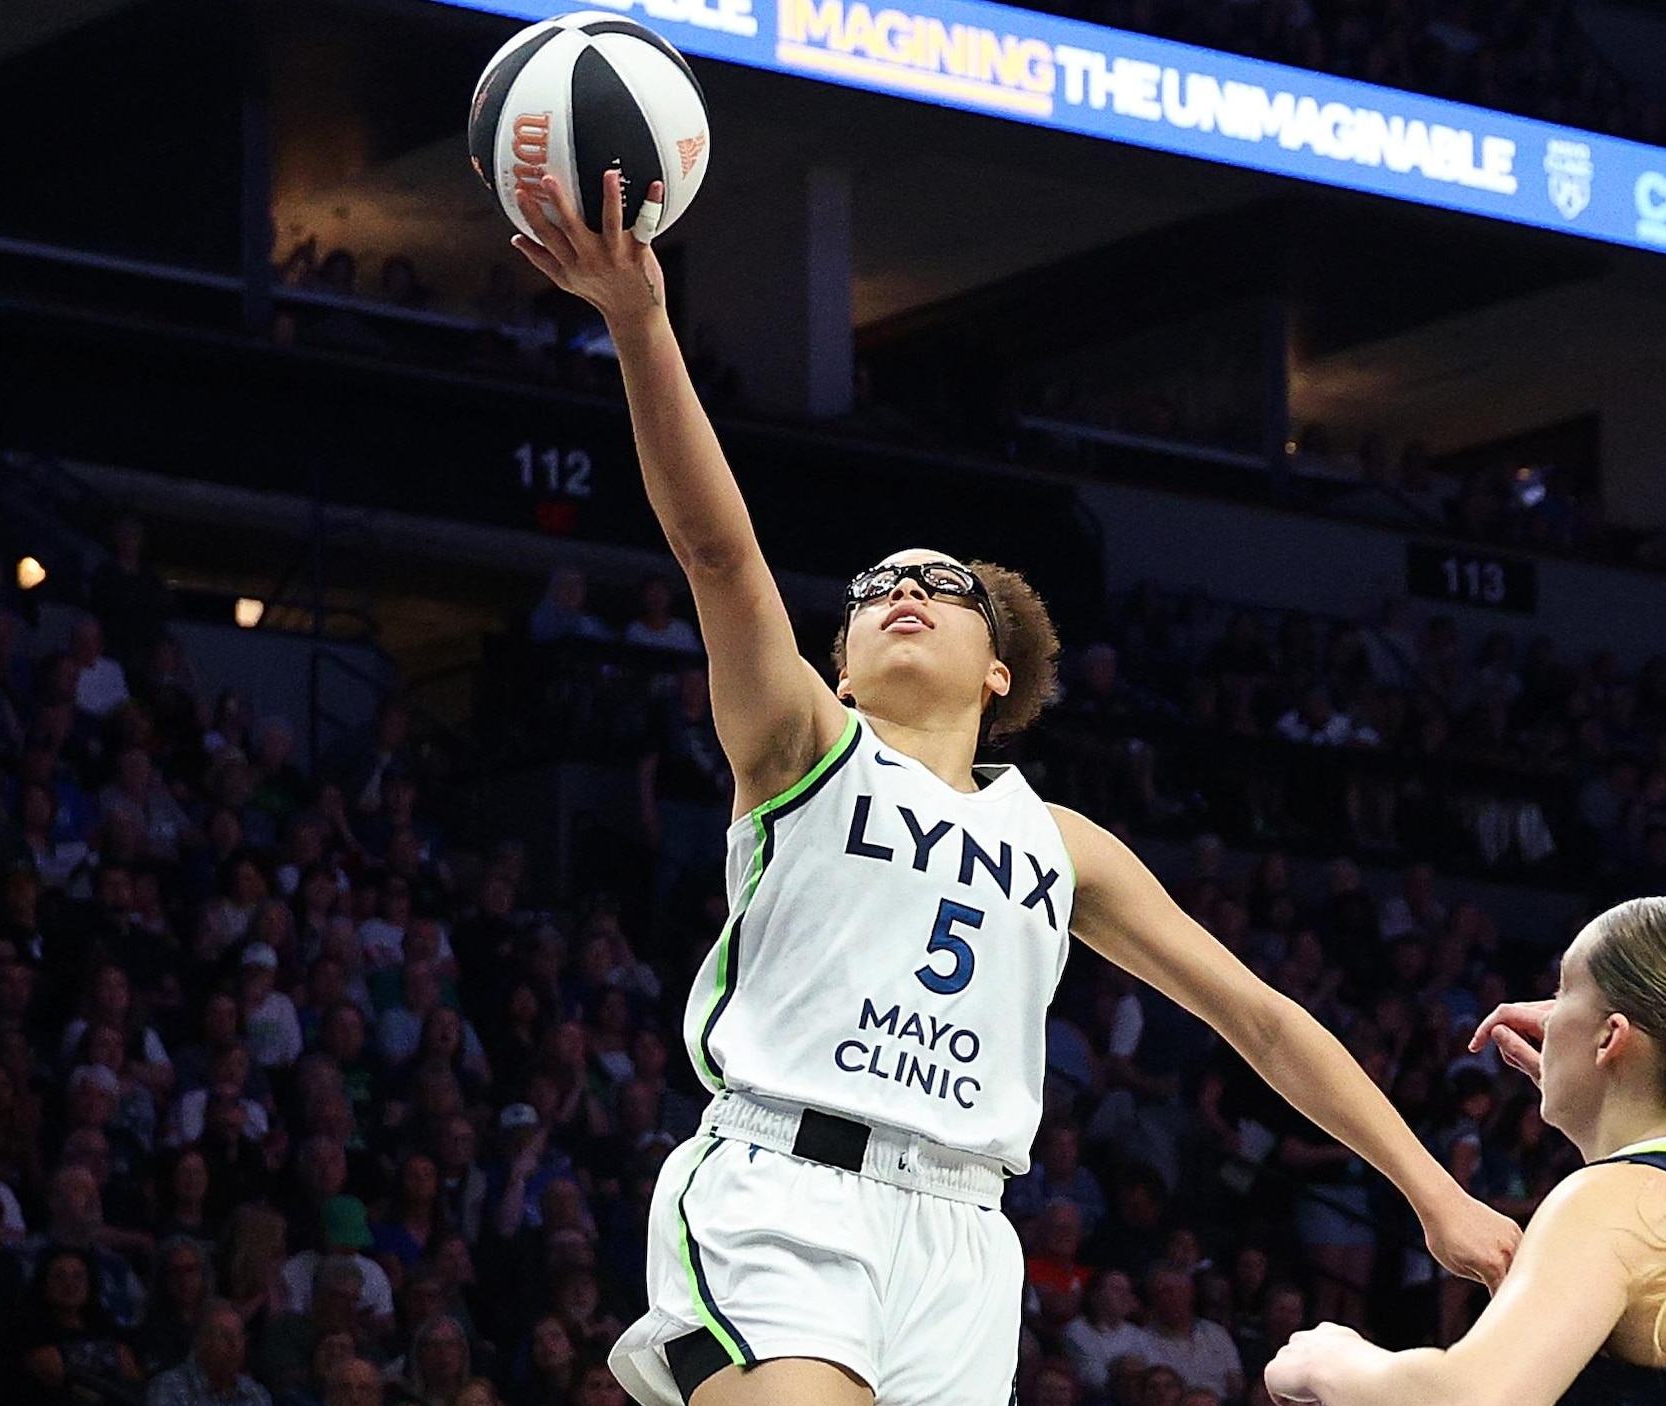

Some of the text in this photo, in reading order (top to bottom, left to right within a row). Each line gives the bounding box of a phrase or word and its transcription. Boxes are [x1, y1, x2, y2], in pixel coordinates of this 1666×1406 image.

[781, 0, 1056, 92] IMAGINING
[1056, 44, 1162, 122] THE
[1162, 70, 1517, 194] UNIMAGINABLE
[512, 441, 593, 497] 112
[1441, 558, 1507, 603] 113
[845, 795, 1059, 931] LYNX
[914, 898, 985, 995] 5
[858, 998, 980, 1063] MAYO
[835, 1040, 981, 1109] CLINIC
